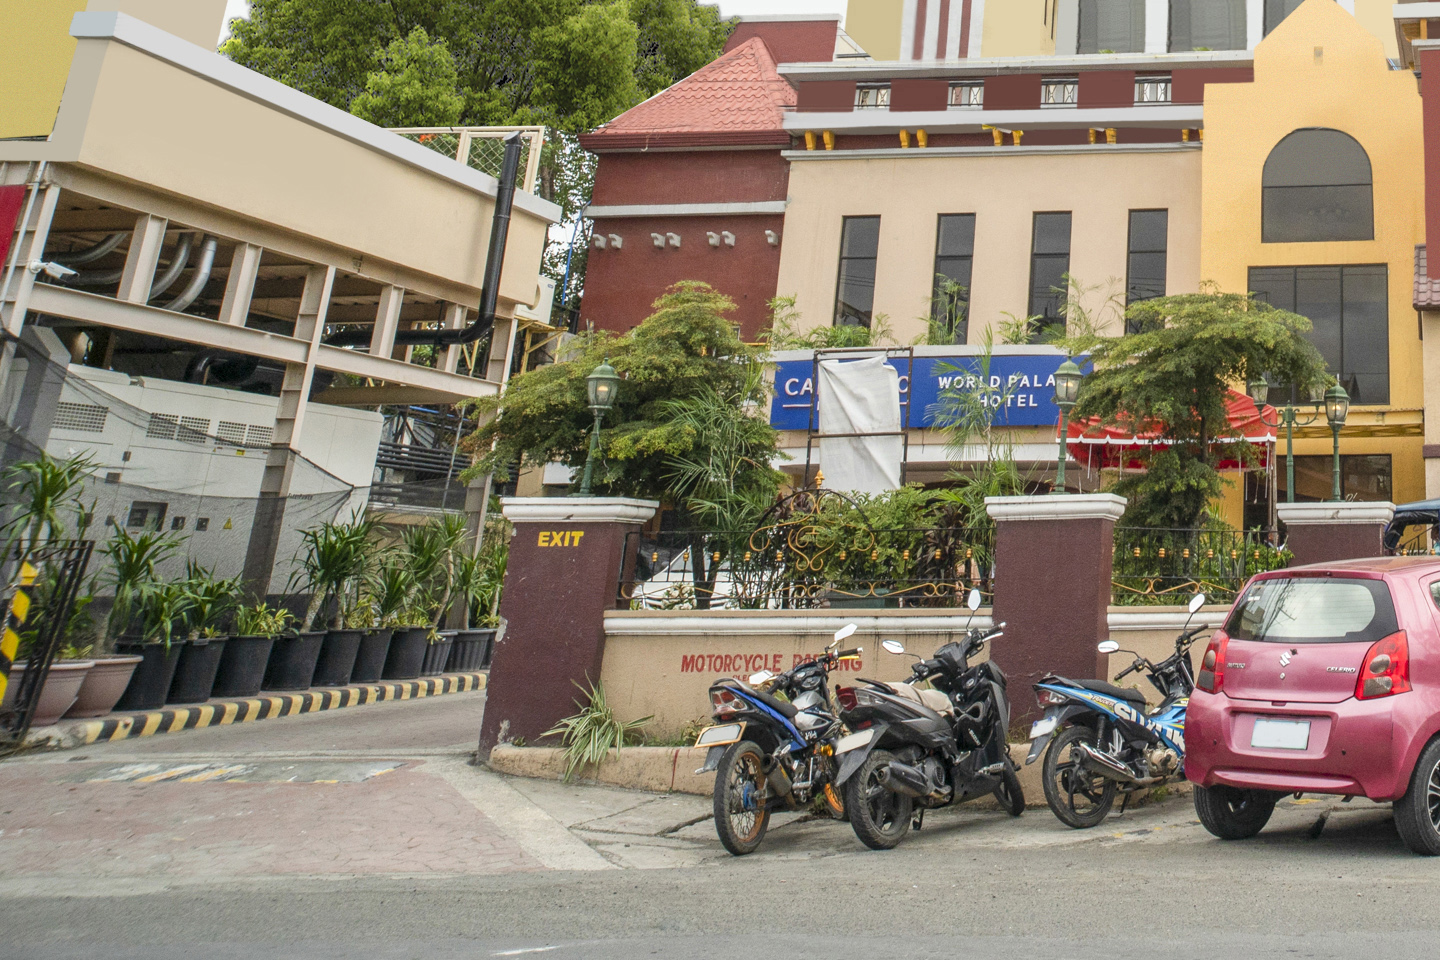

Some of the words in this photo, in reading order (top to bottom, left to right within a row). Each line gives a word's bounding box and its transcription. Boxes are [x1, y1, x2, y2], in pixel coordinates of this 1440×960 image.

[978, 394, 1038, 408] HOTEL
[537, 530, 585, 547] EXIT
[680, 653, 783, 673] MOTORCYCLE
